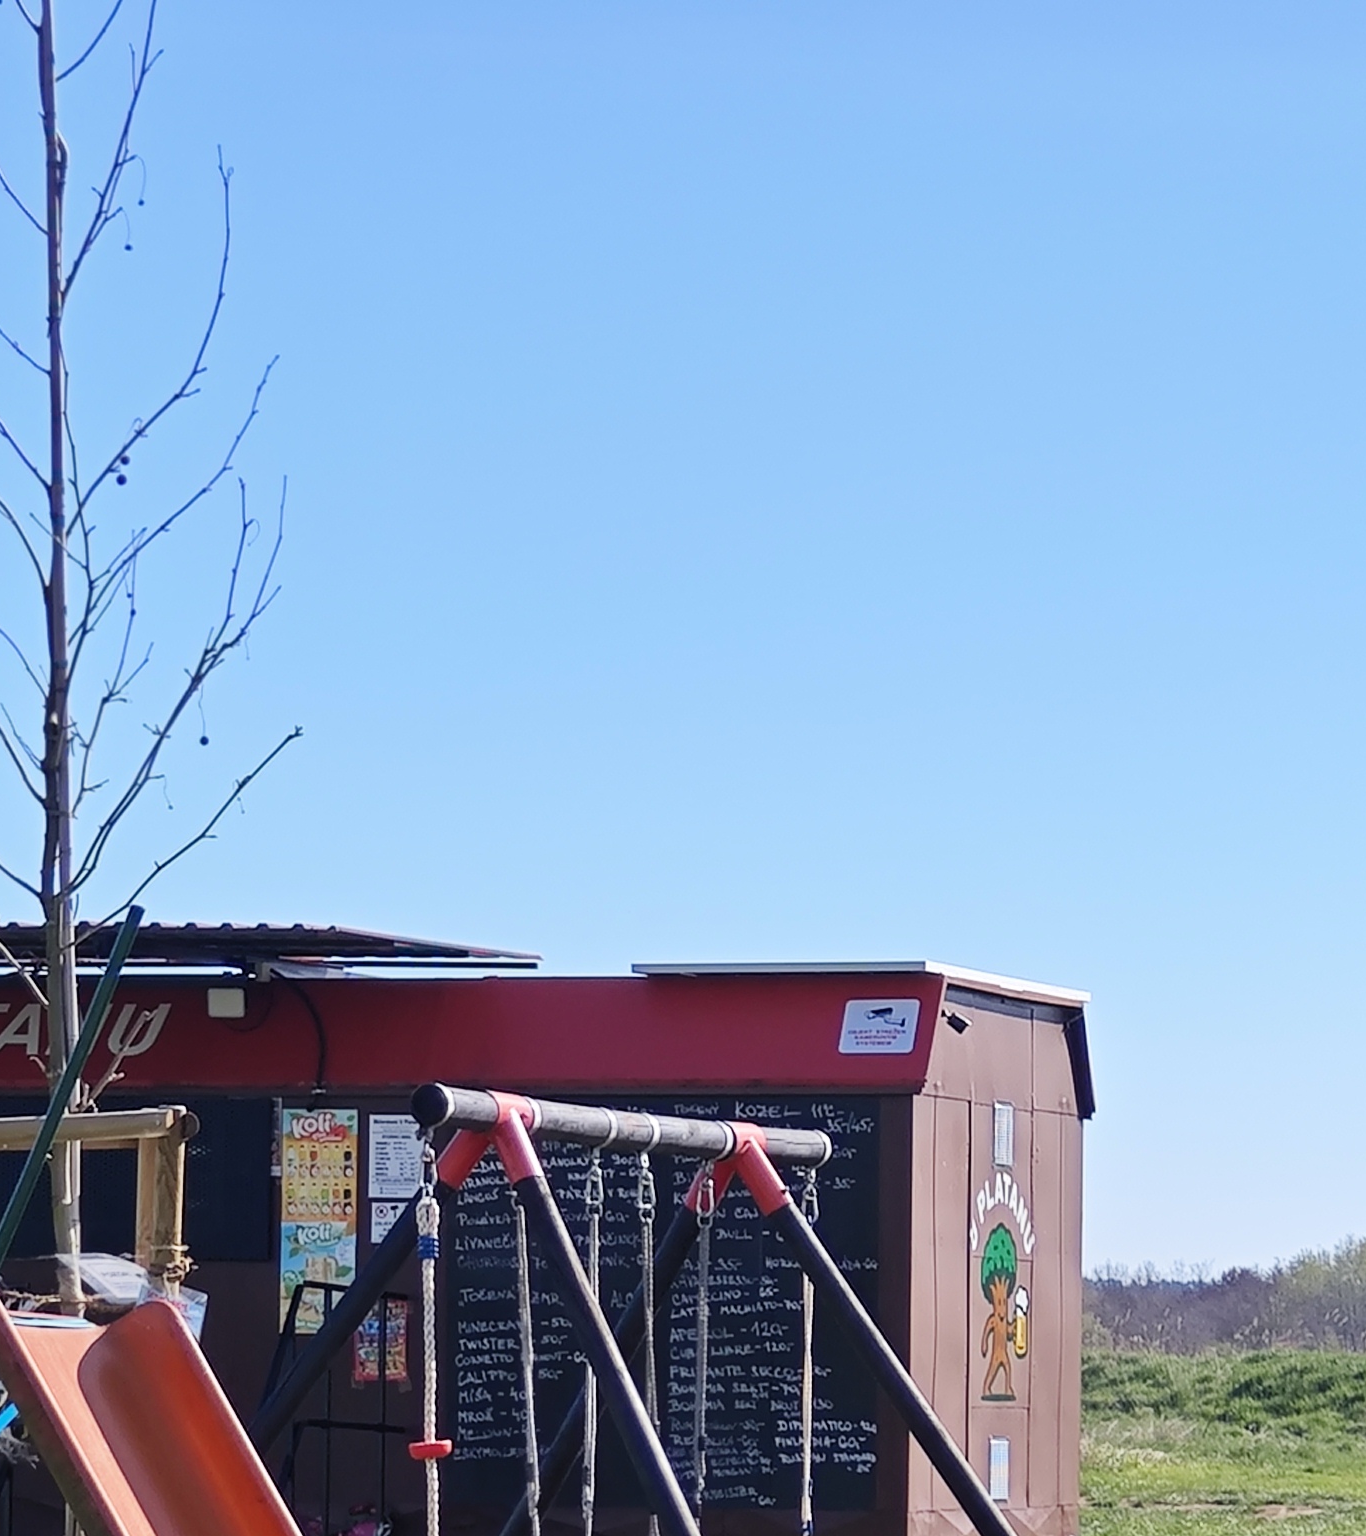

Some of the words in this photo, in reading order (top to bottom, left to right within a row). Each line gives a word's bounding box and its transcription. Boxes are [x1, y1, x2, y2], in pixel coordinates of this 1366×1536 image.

[735, 1101, 802, 1118] KOZEL
[976, 1171, 1036, 1255] PLATANU
[458, 1337, 521, 1352] TWISTER
[457, 1368, 518, 1388] CALIPPO
